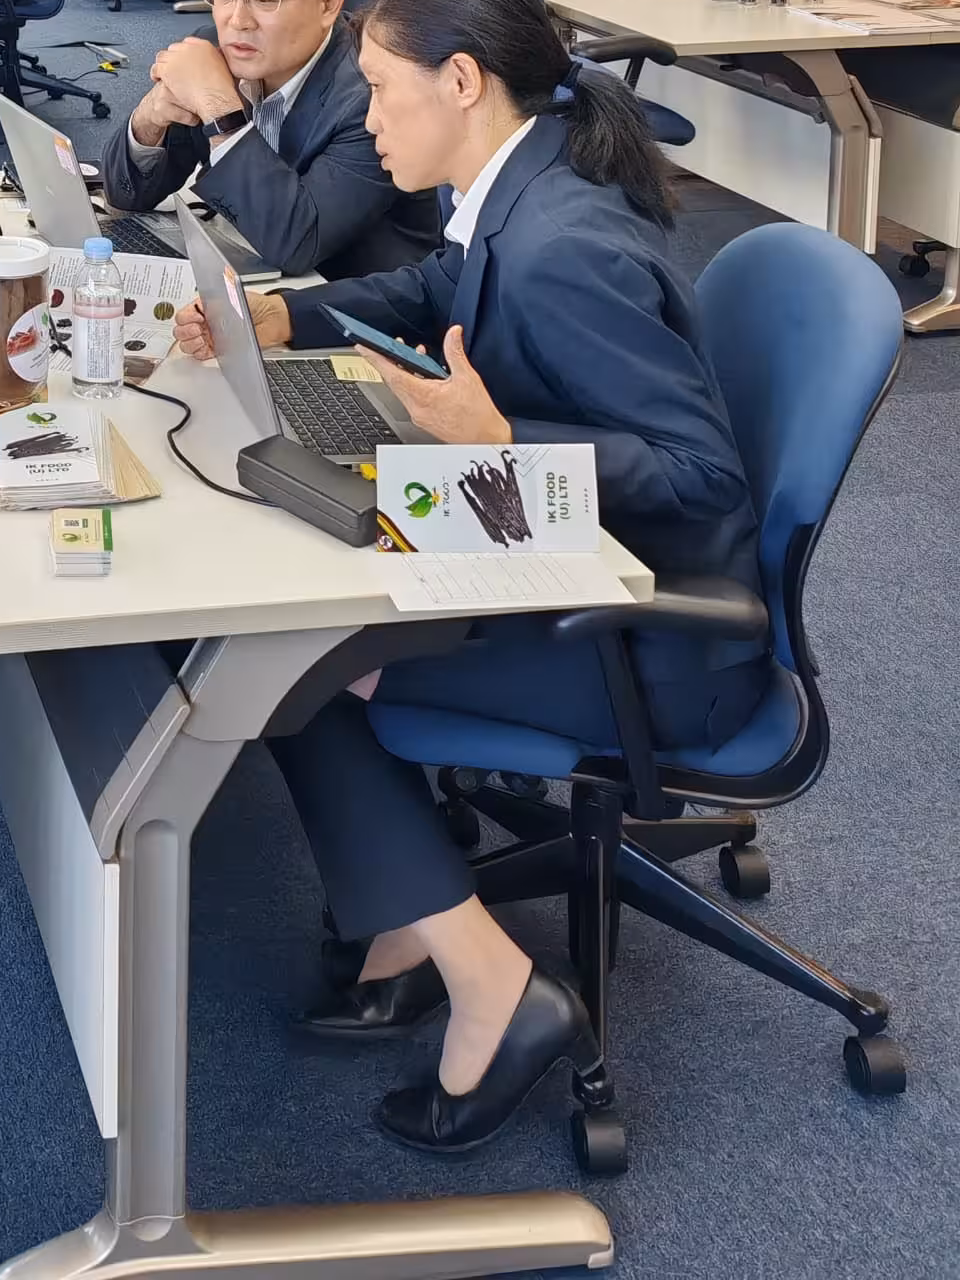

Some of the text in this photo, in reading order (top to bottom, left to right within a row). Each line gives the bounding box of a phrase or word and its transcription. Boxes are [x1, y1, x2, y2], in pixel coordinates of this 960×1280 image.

[546, 471, 556, 523] IK FOOD
[558, 475, 571, 520] (U) LTD
